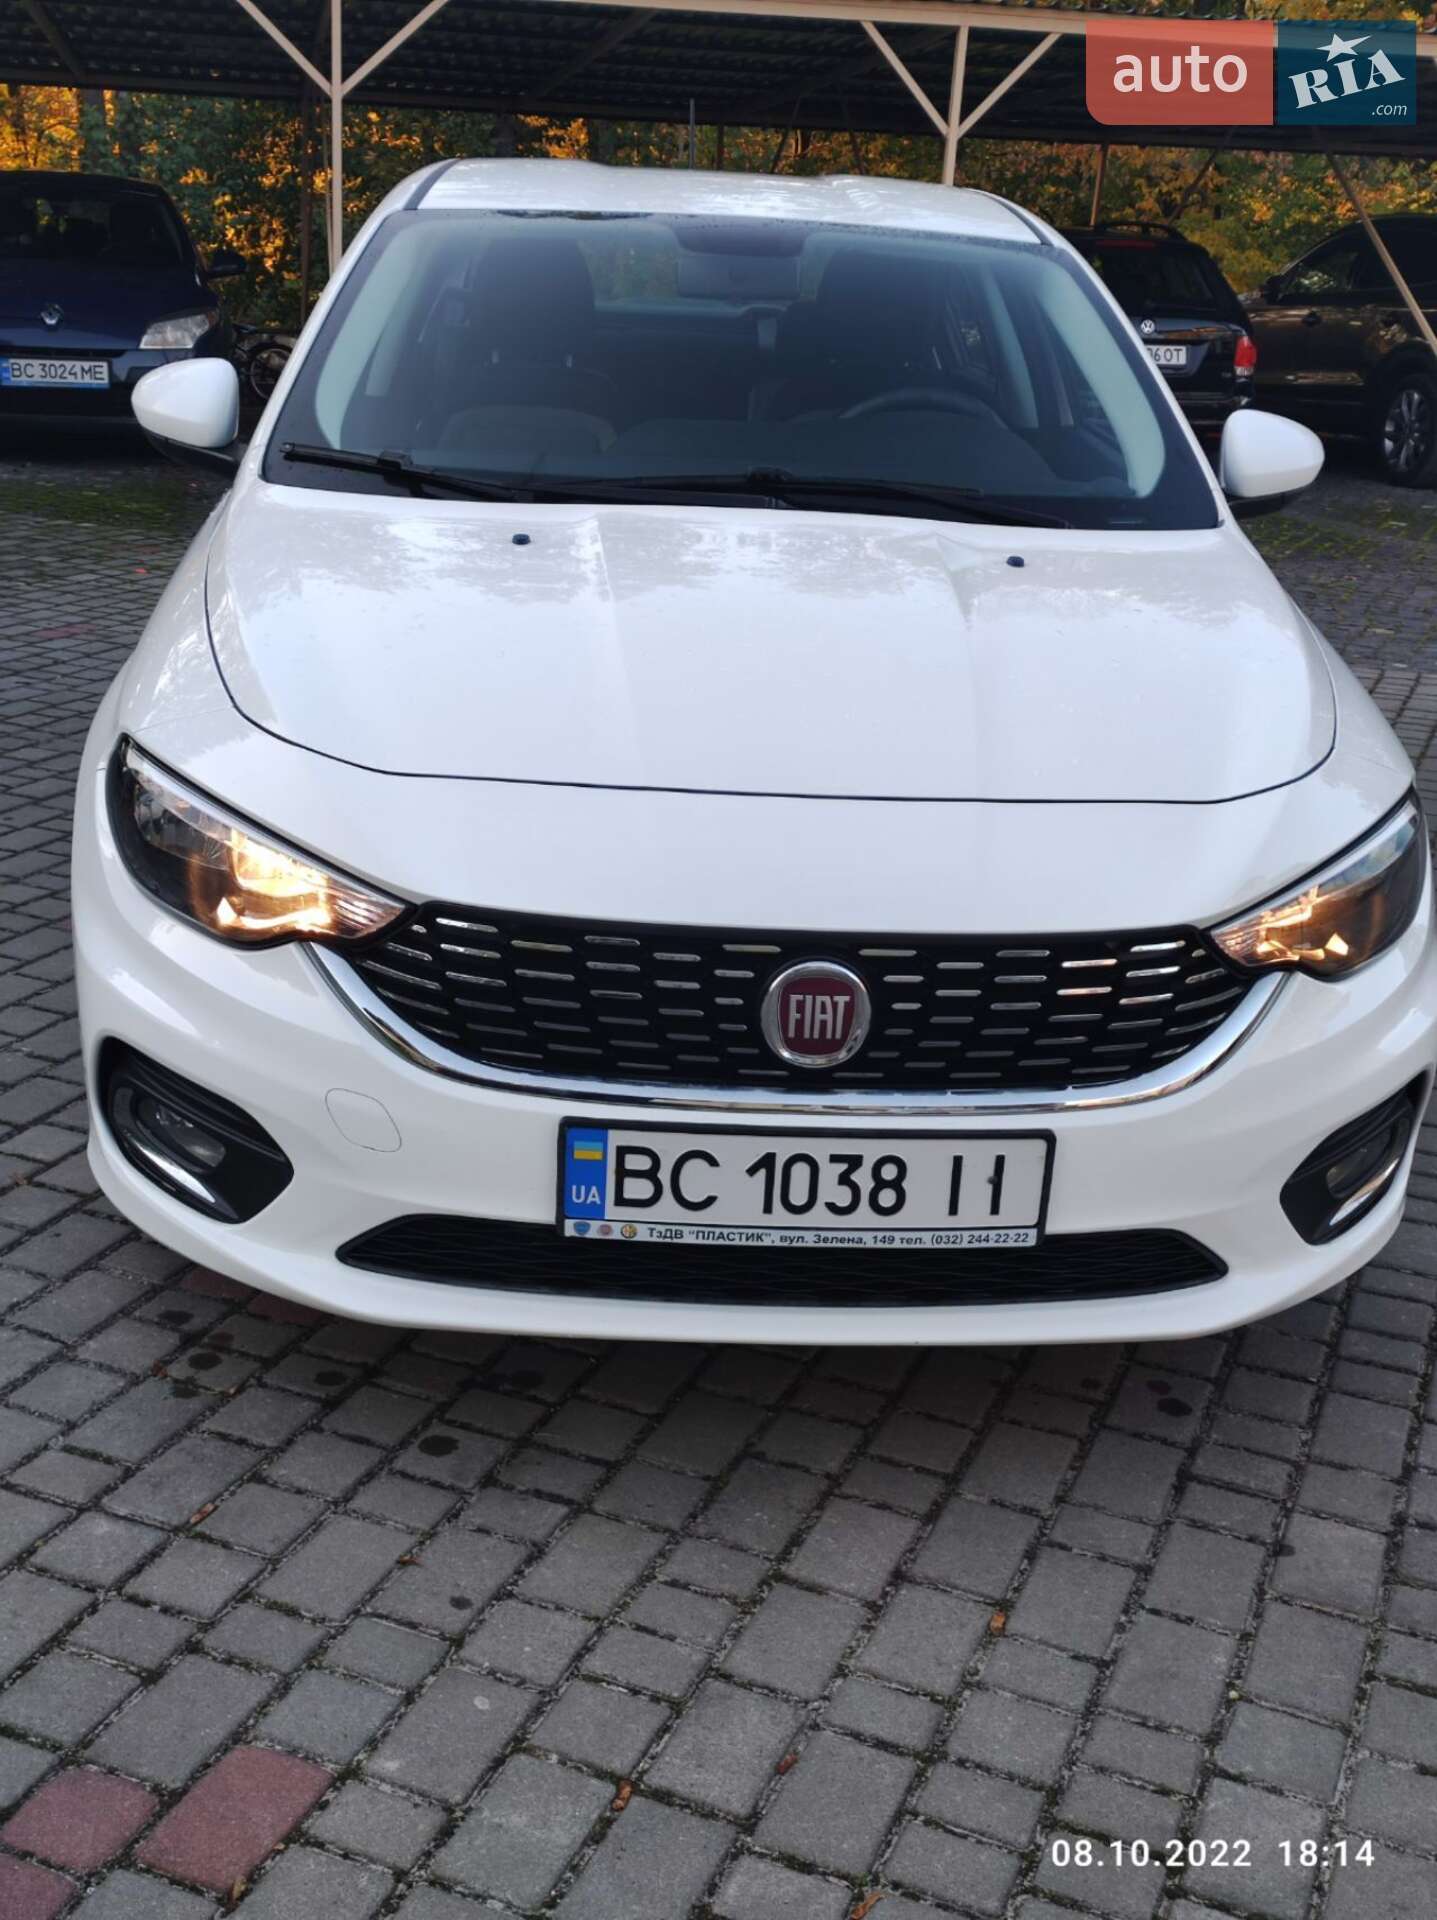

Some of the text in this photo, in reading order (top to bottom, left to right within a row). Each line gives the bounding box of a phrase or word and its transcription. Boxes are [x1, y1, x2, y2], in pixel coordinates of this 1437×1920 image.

[10, 362, 35, 379] BC
[39, 363, 78, 380] 3024
[80, 364, 105, 381] ME
[788, 994, 851, 1039] FIAT
[613, 1145, 720, 1212] BC
[745, 1152, 908, 1217] 1038
[571, 1184, 602, 1205] UA
[779, 1234, 808, 1246] вул.
[812, 1234, 867, 1246] Зелена,
[871, 1235, 895, 1245] 149
[899, 1236, 926, 1246] тел.
[930, 1233, 963, 1246] (032)
[967, 1232, 1029, 1245] 244-22-22
